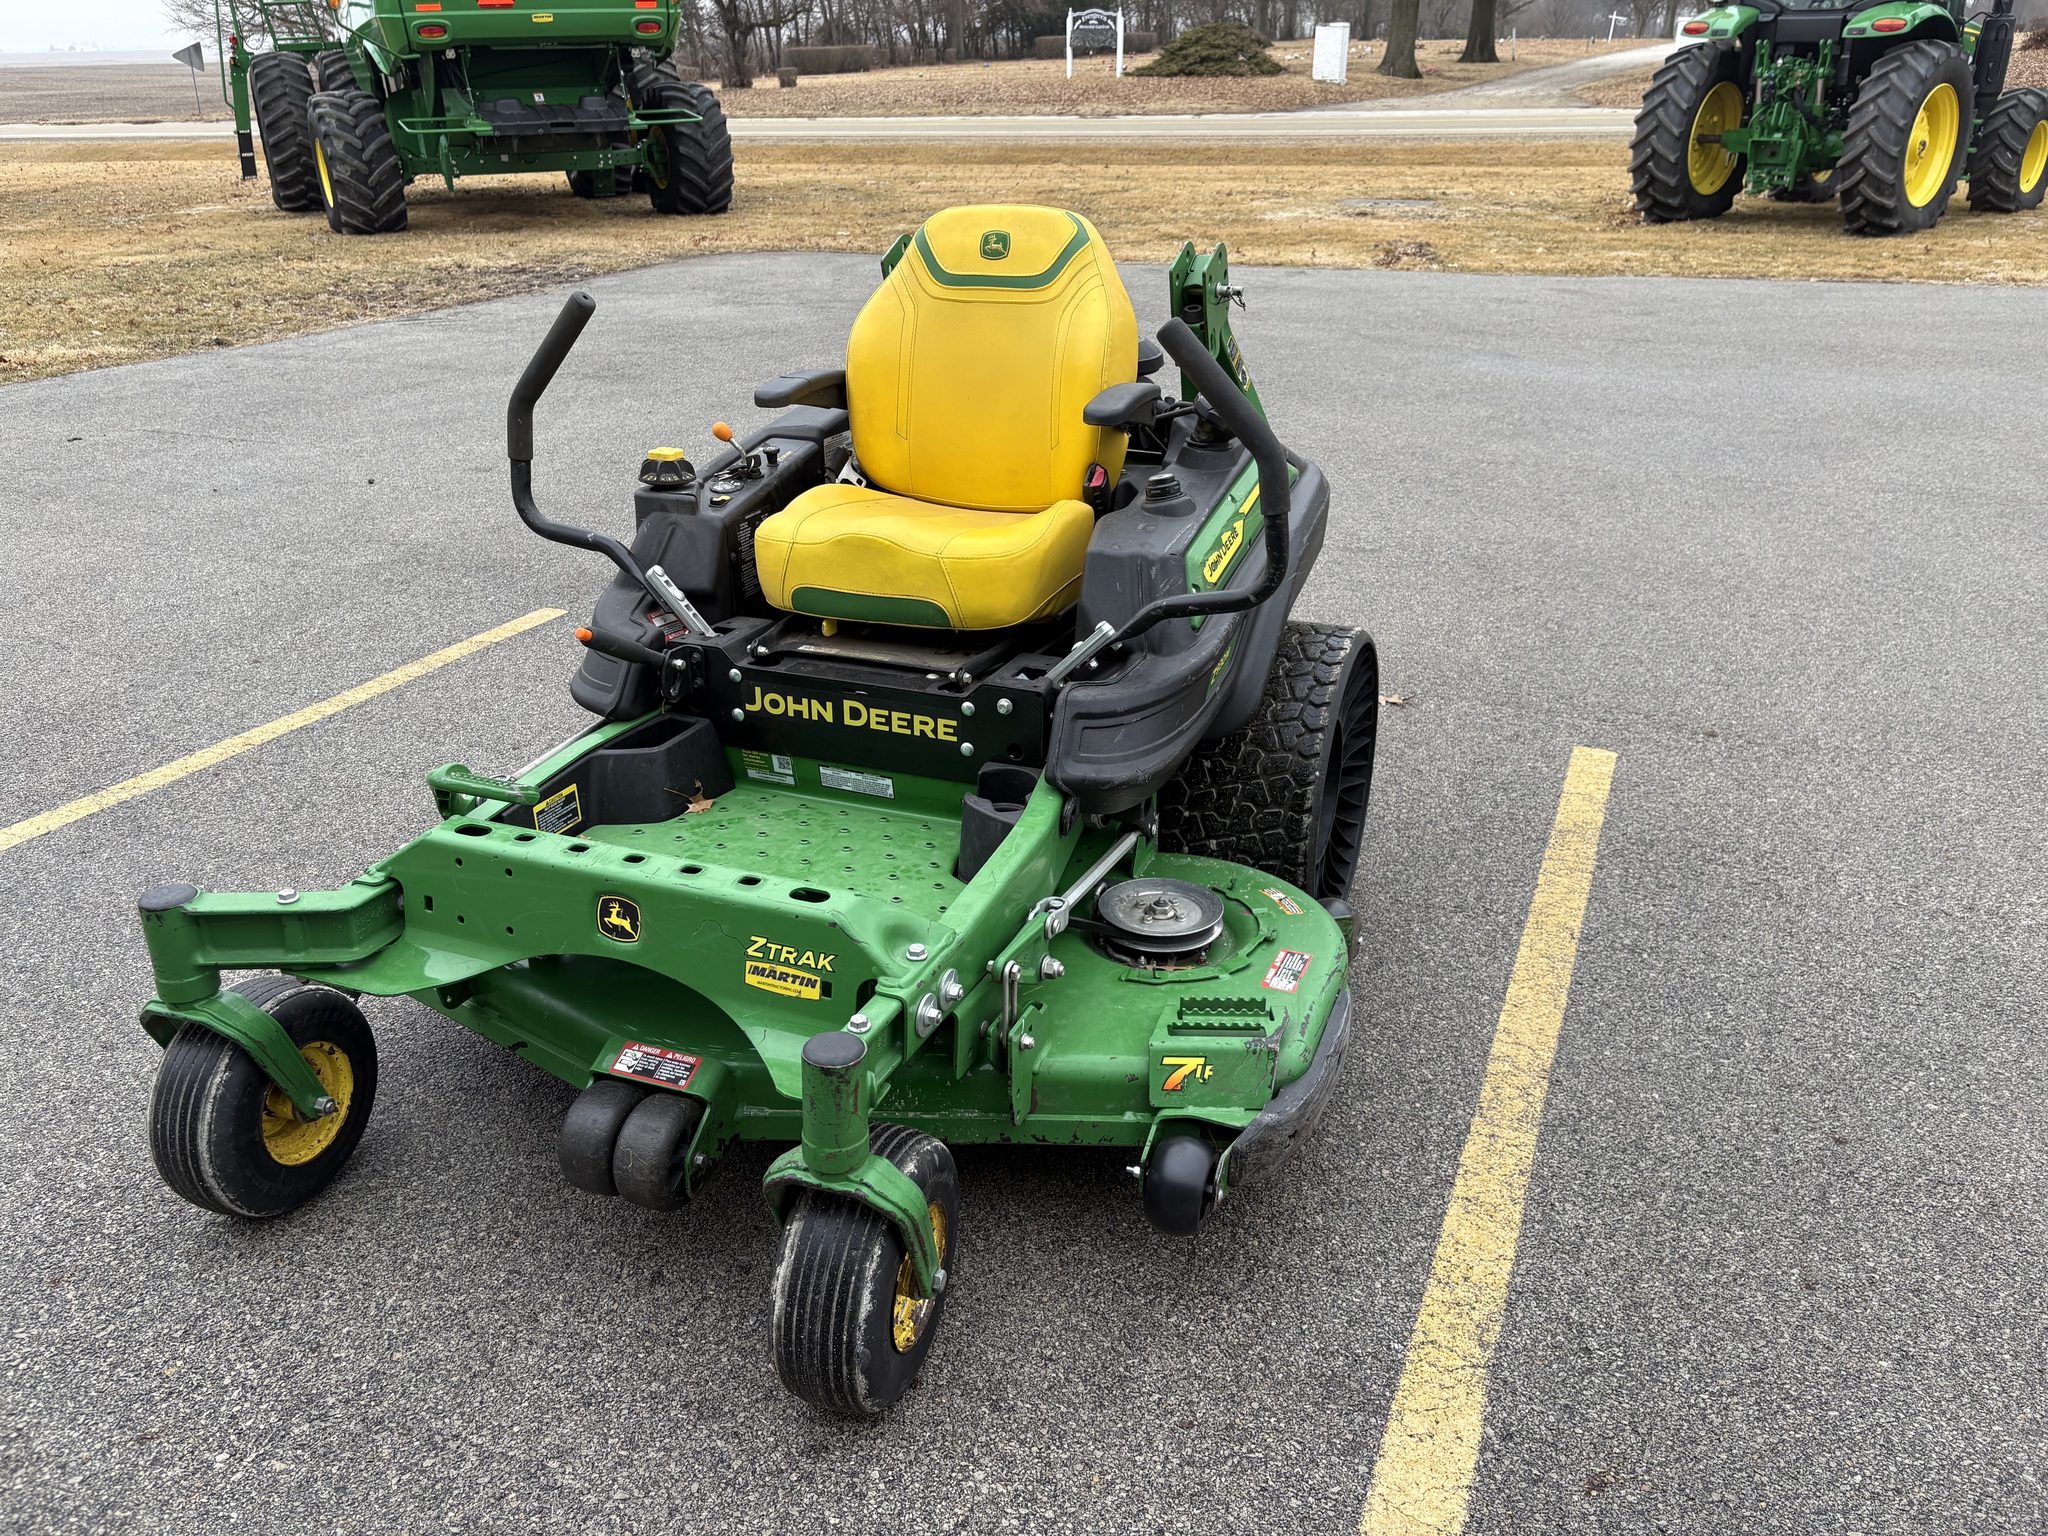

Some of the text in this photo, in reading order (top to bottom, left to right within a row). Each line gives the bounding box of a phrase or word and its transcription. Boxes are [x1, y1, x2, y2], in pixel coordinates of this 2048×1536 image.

[745, 686, 958, 742] JOHN DEERE
[745, 934, 838, 973] ZTRAK
[748, 964, 819, 989] MARTIN
[639, 1045, 661, 1055] DANGER
[673, 1053, 697, 1063] PELIGRO
